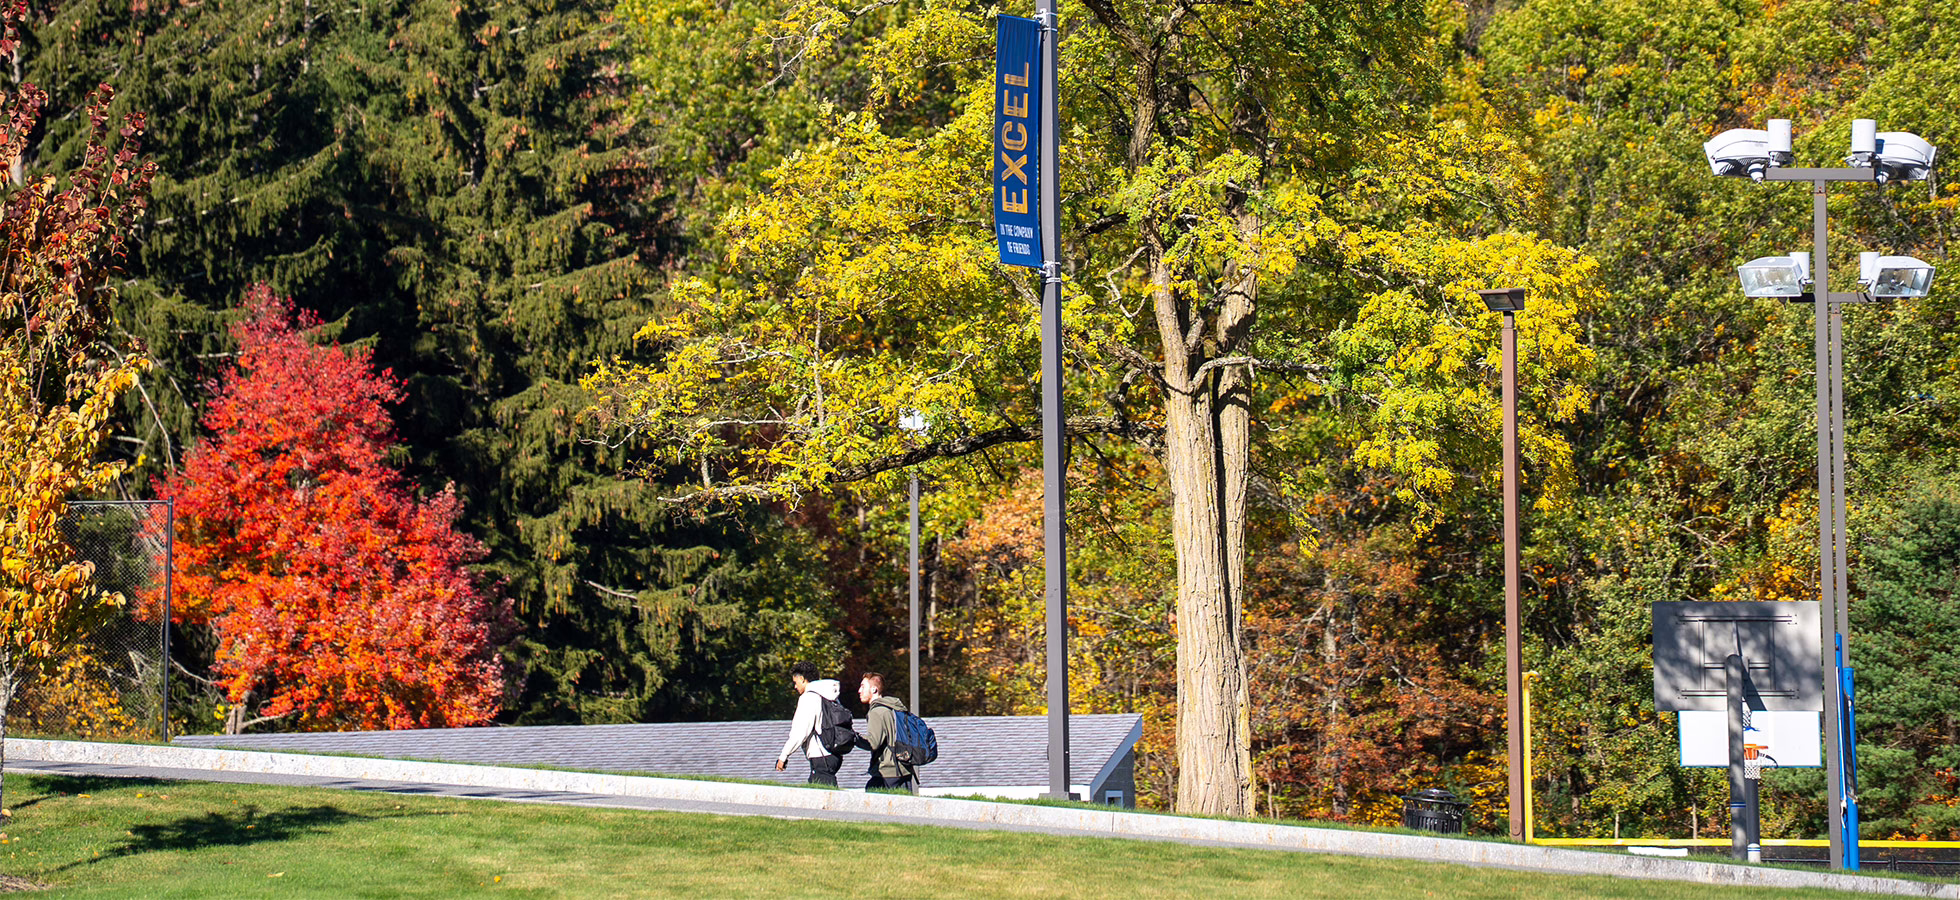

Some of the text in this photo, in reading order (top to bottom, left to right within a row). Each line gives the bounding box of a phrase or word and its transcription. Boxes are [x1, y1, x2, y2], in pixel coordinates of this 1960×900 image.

[1001, 62, 1029, 214] EXCEL
[1005, 224, 1013, 236] THE
[1013, 225, 1033, 239] COMPANY
[1013, 242, 1030, 255] FRIENDS
